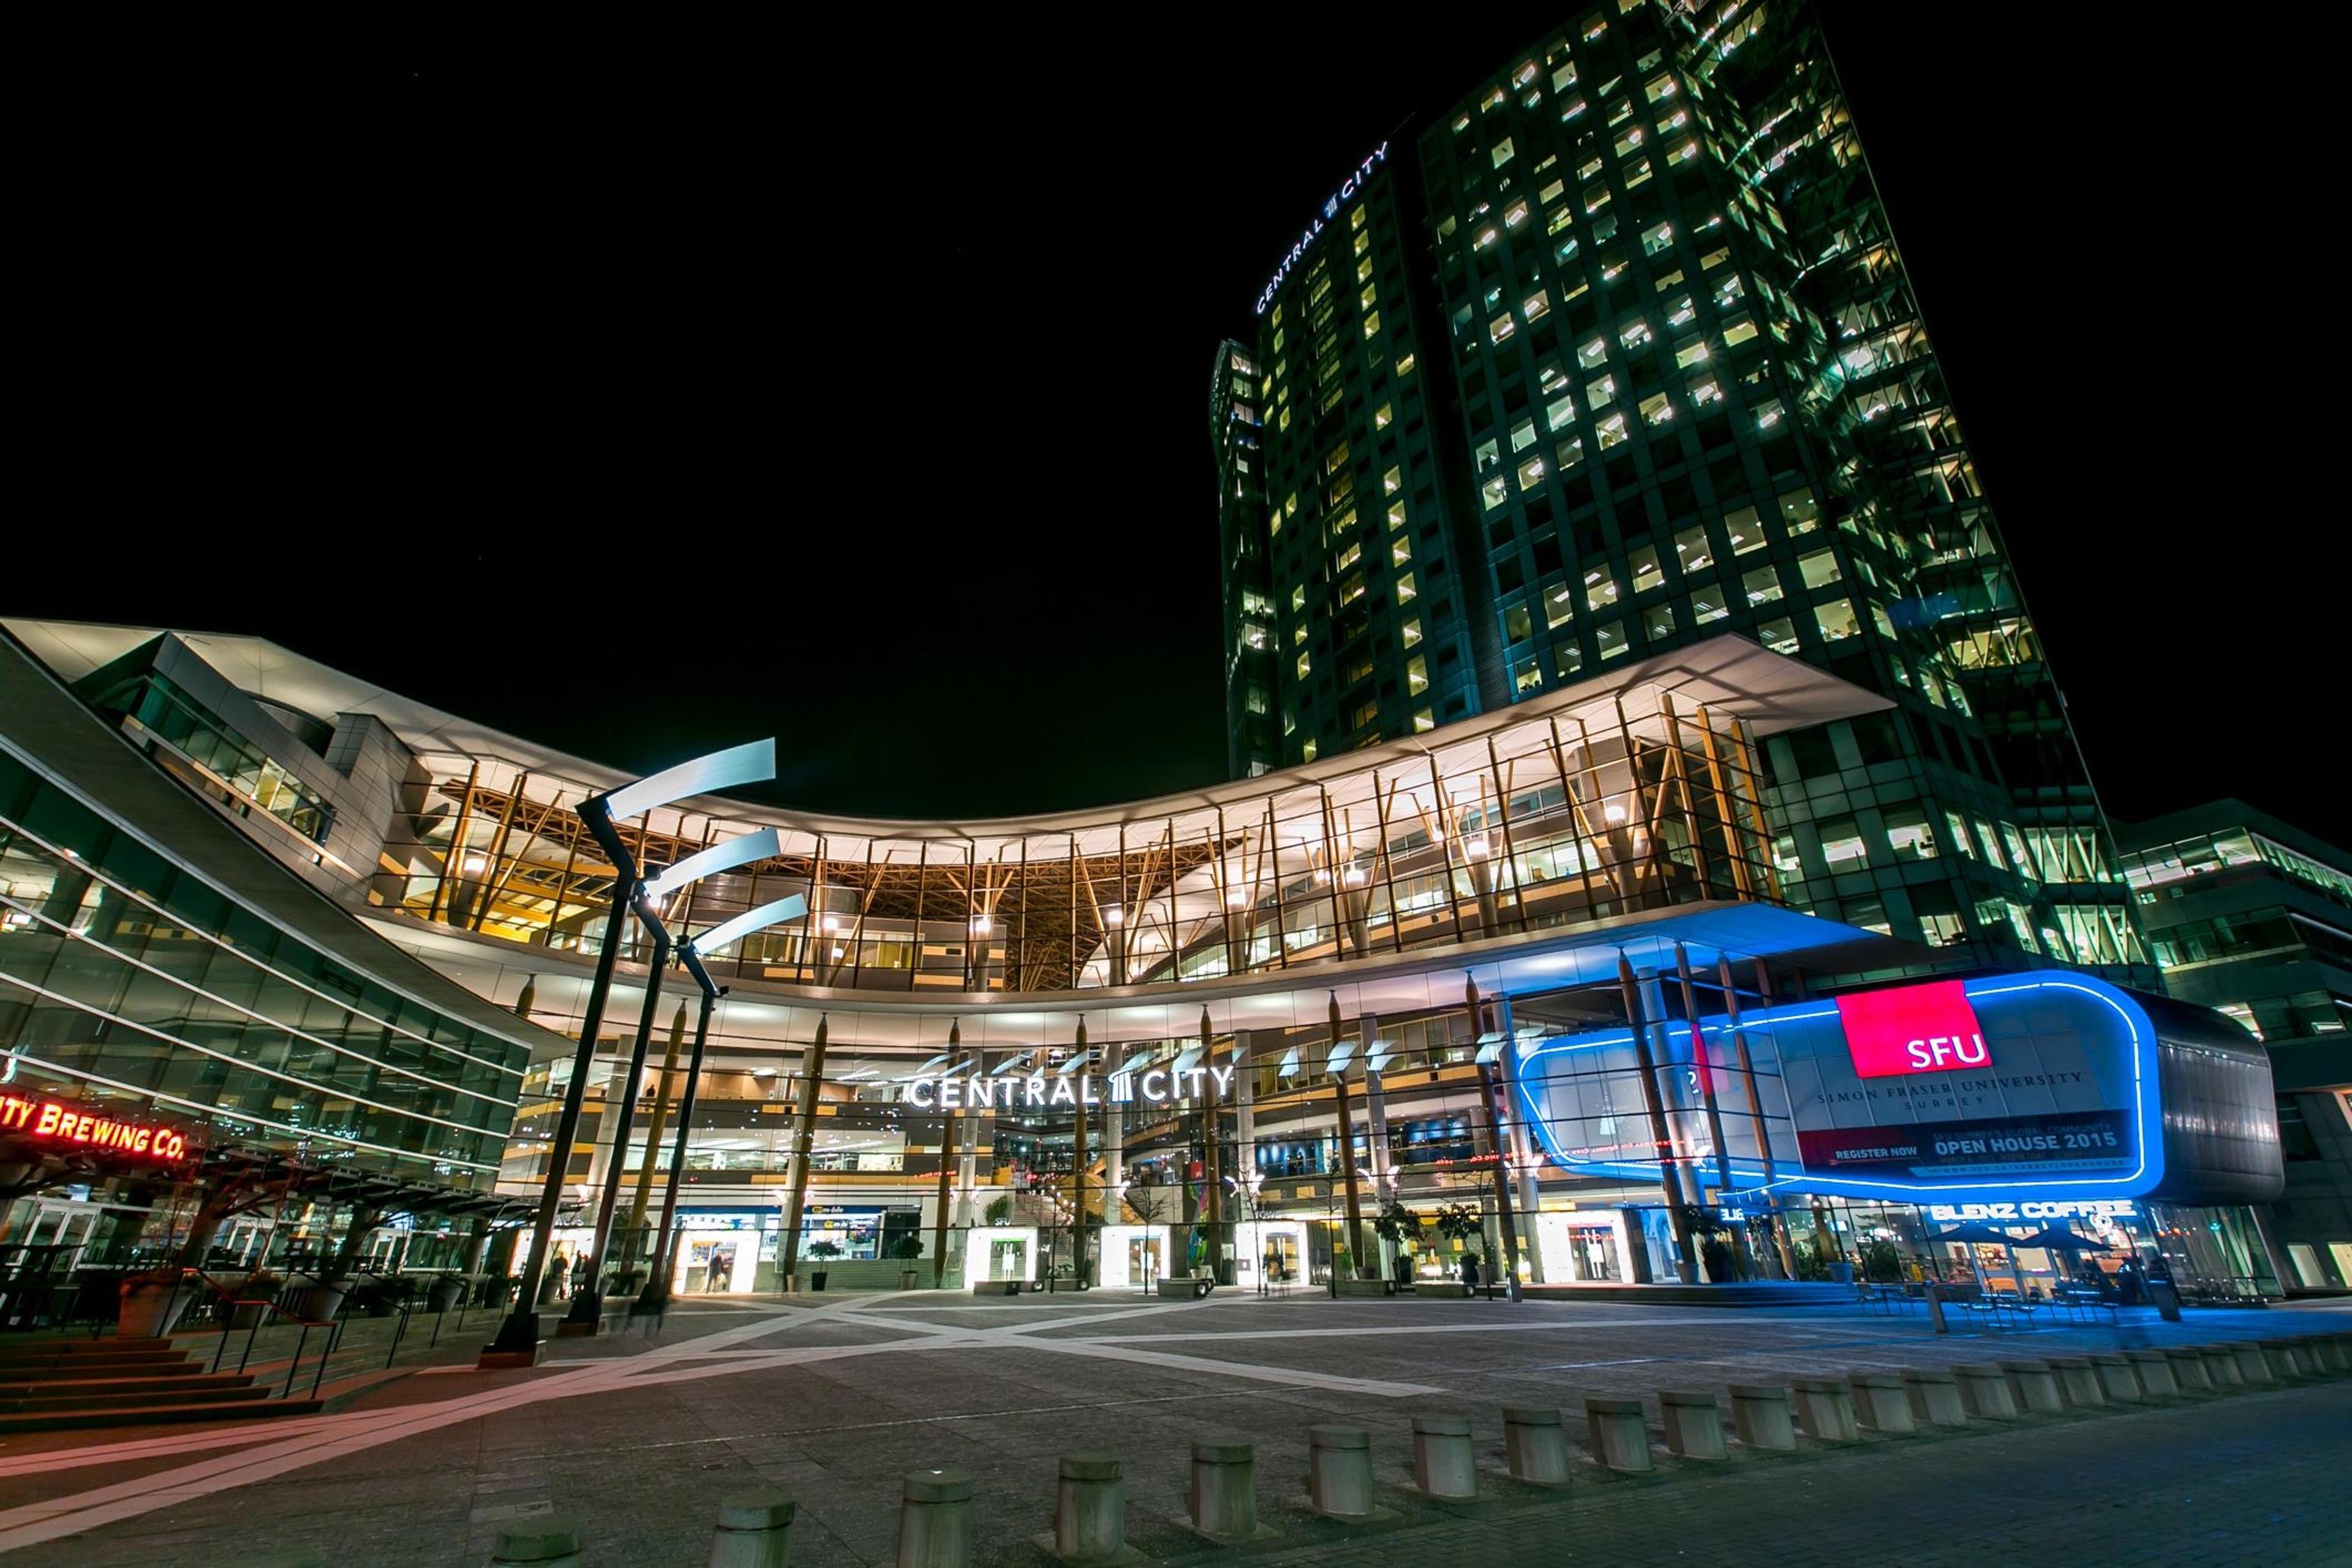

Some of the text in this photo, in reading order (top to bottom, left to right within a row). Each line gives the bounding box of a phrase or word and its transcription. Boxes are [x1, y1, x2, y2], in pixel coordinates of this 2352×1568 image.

[1257, 140, 1388, 314] CENTRAL CITY
[1907, 1033, 1986, 1069] SFU
[910, 1066, 1234, 1108] CENTRAL CITY
[1818, 1071, 2083, 1104] SIMON FRASER UNIVERSITY
[1905, 1095, 1983, 1110] SURREY
[35, 1103, 149, 1153] BREWING
[1836, 1146, 1918, 1159] REGISTER NOW
[1935, 1139, 1987, 1155] OPEN
[1990, 1136, 2060, 1153] HOUSE
[2063, 1132, 2117, 1148] 2015
[995, 1217, 1011, 1226] SFU
[1929, 1199, 2138, 1221] BLENZ COFFEE
